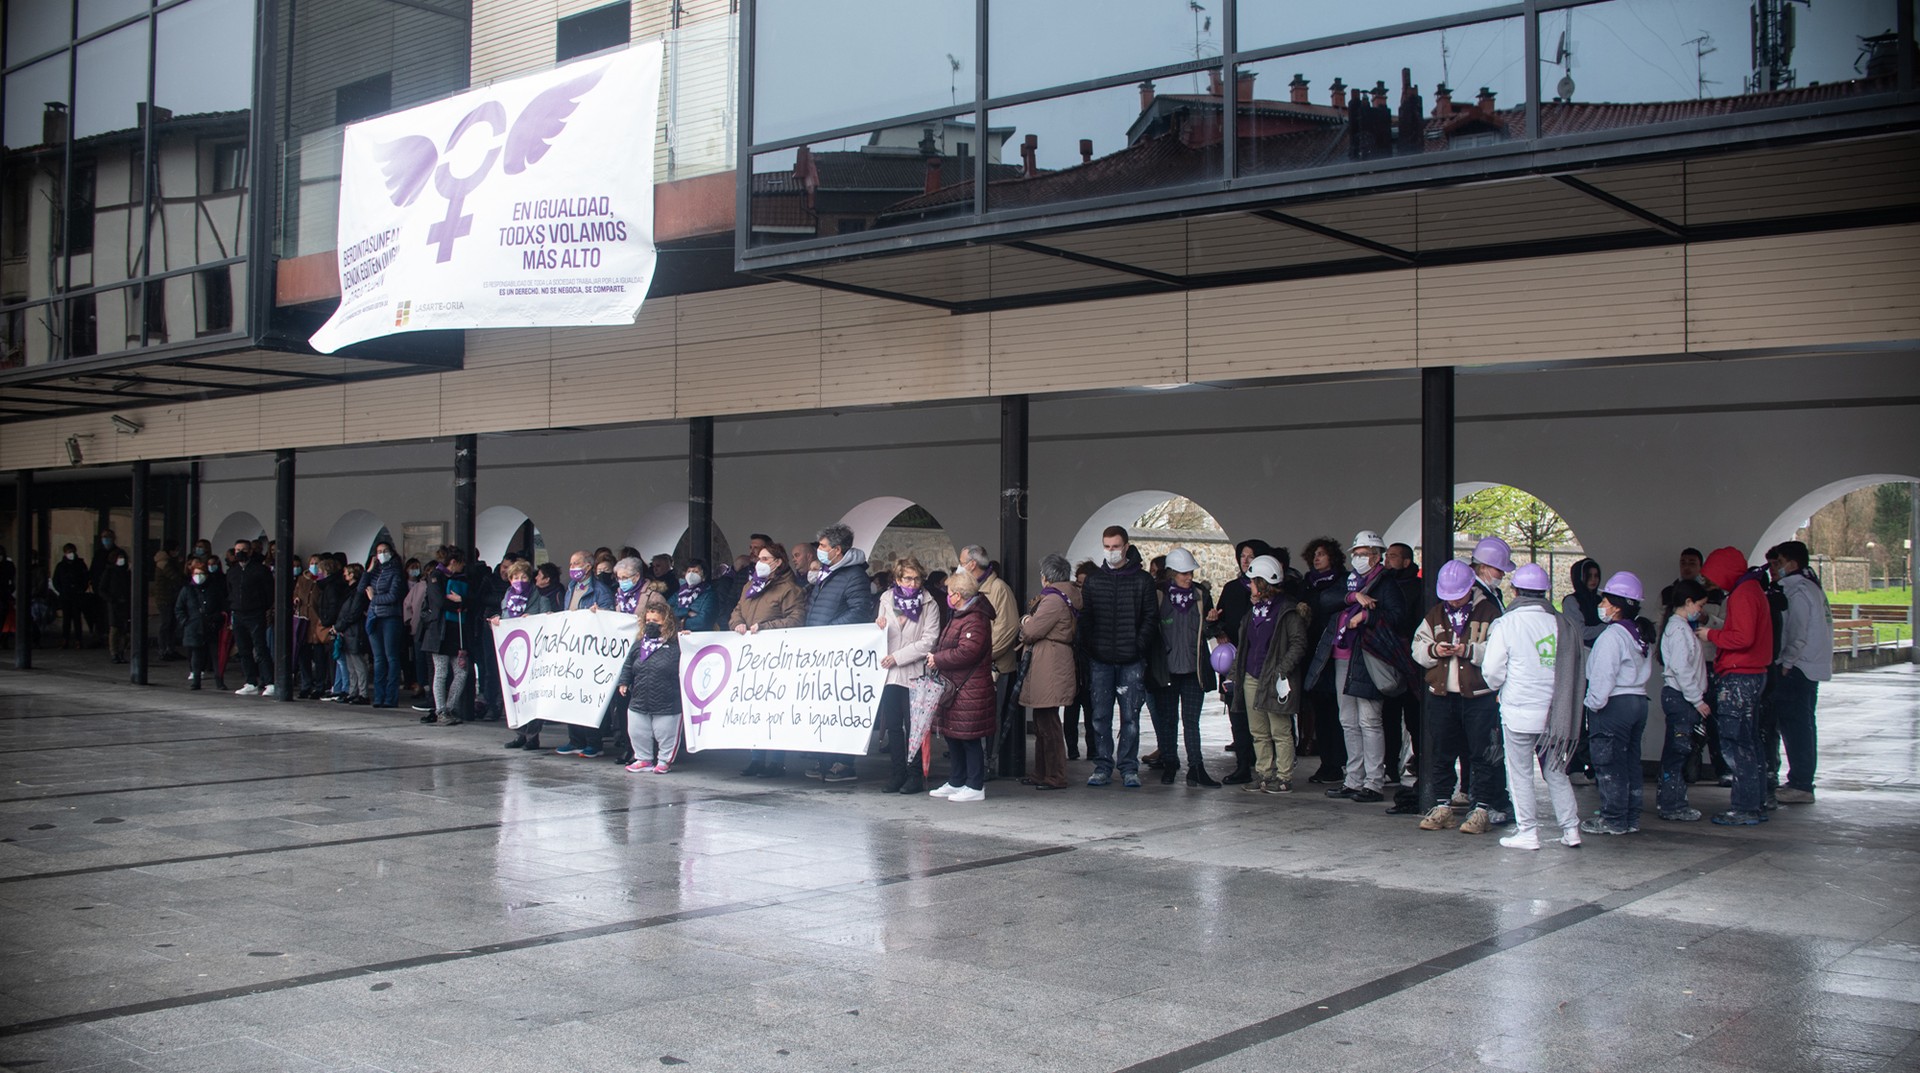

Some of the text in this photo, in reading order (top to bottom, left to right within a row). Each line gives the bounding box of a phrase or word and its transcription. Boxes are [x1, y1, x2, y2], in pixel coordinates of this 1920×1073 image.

[513, 196, 614, 221] EN IGUALDAD,
[499, 221, 627, 246] TODXS VOLAMOS
[523, 245, 600, 270] MÁS ALTO
[499, 288, 506, 296] ES
[506, 288, 514, 296] UN
[541, 287, 549, 295] NO
[415, 301, 465, 312] LASARTE-ORIA
[736, 640, 879, 672] Berdintasunaren
[560, 685, 575, 701] de
[580, 688, 593, 705] las
[730, 667, 876, 703] aldeko ibilaldia
[722, 704, 872, 743] Marcha por la igualdad
